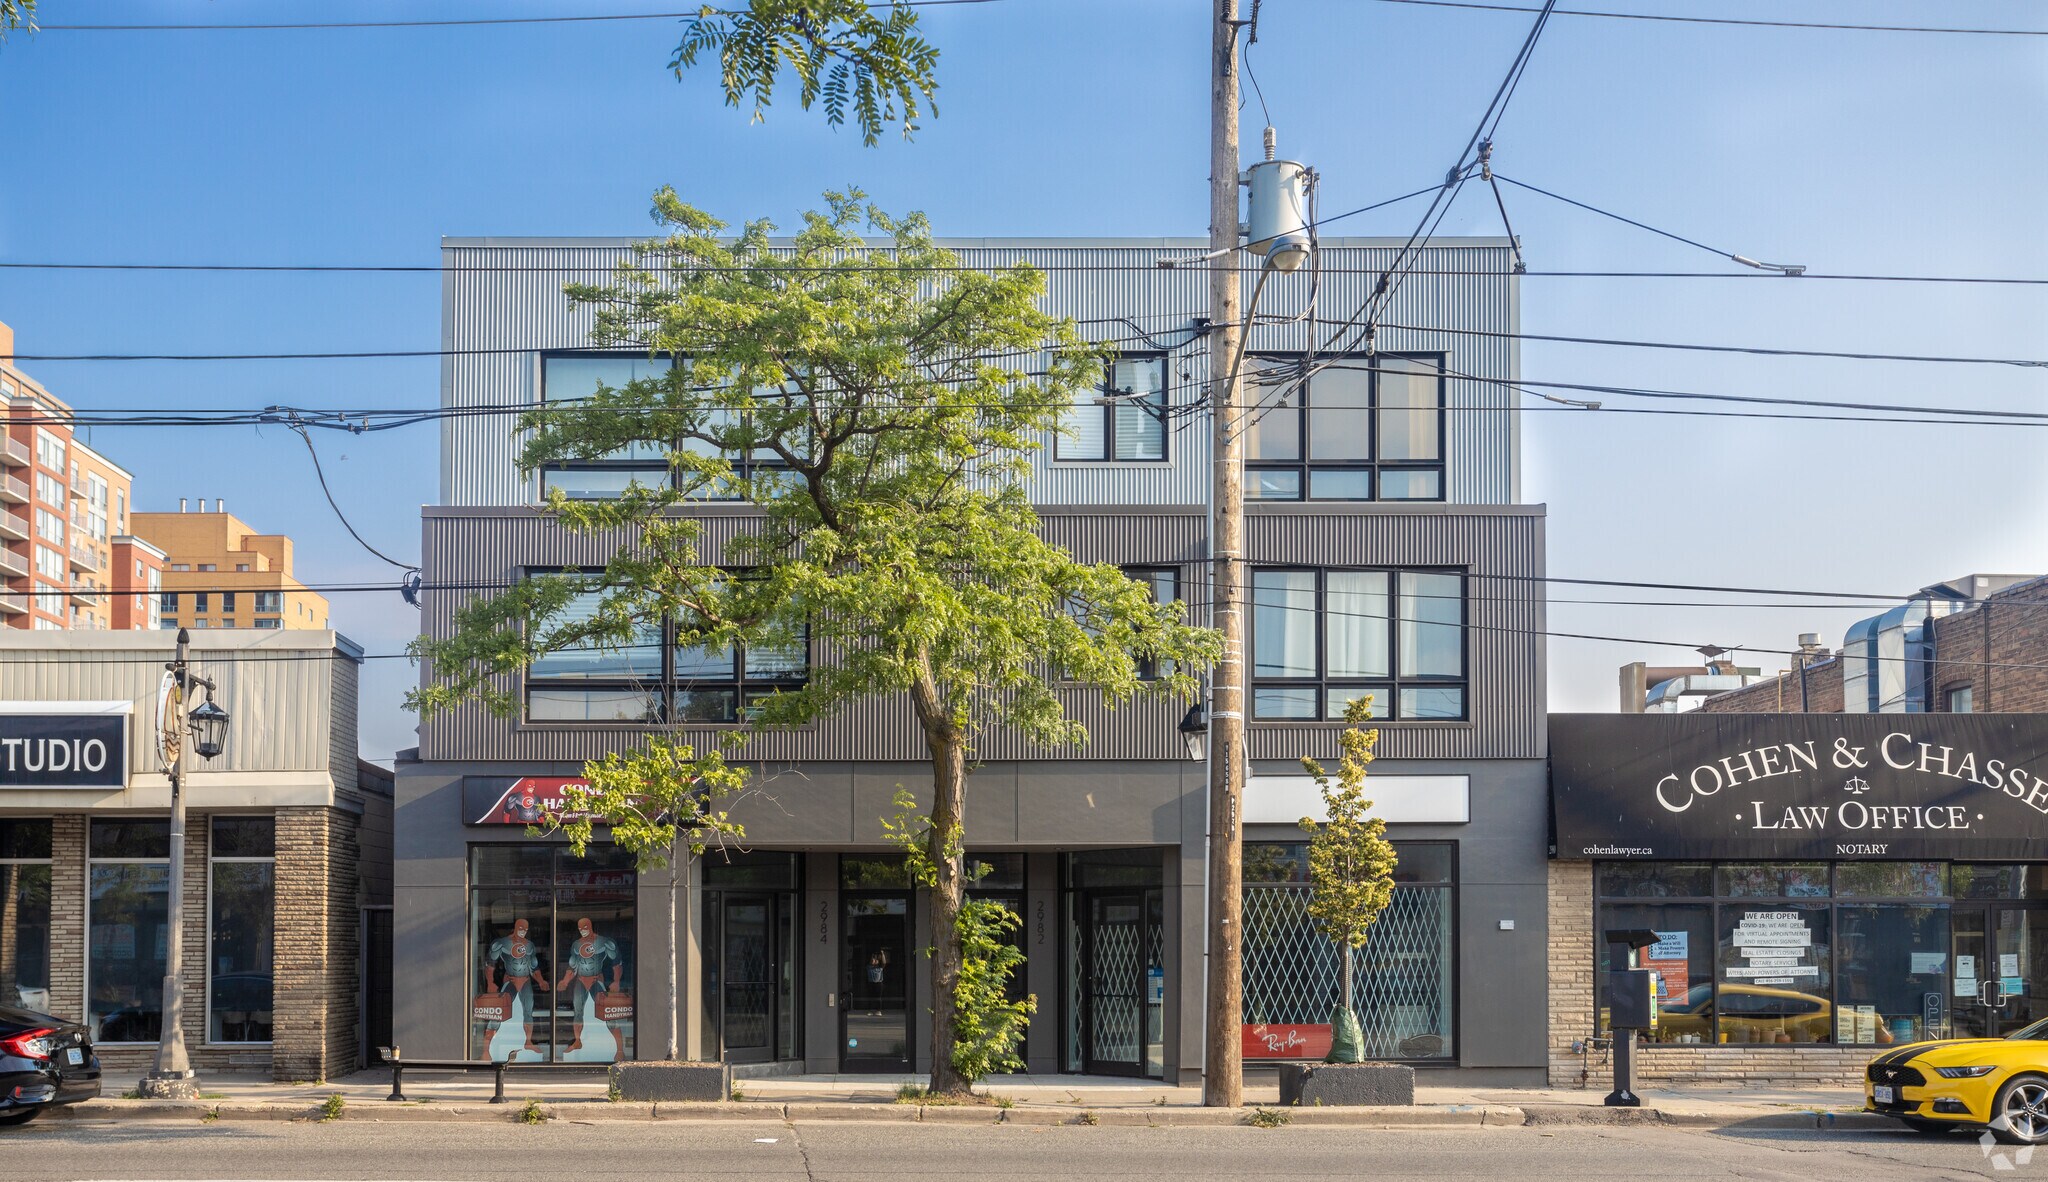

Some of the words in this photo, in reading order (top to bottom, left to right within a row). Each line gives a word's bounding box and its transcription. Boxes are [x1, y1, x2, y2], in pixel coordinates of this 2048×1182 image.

[0, 738, 107, 772] TUDIO
[1656, 741, 1818, 813] COHEN
[1832, 737, 1868, 769] &
[1751, 801, 1830, 830] LAW
[1838, 801, 1970, 830] OFFICE
[1583, 844, 1653, 857] cohenlawyer.ca
[1836, 844, 1888, 855] NOTARY
[820, 901, 828, 945] 2984
[1037, 901, 1045, 945] 2982
[1746, 912, 1757, 920] WE
[1760, 912, 1774, 920] ARE
[1776, 912, 1797, 920] OPEN
[474, 1007, 502, 1015] CONDO
